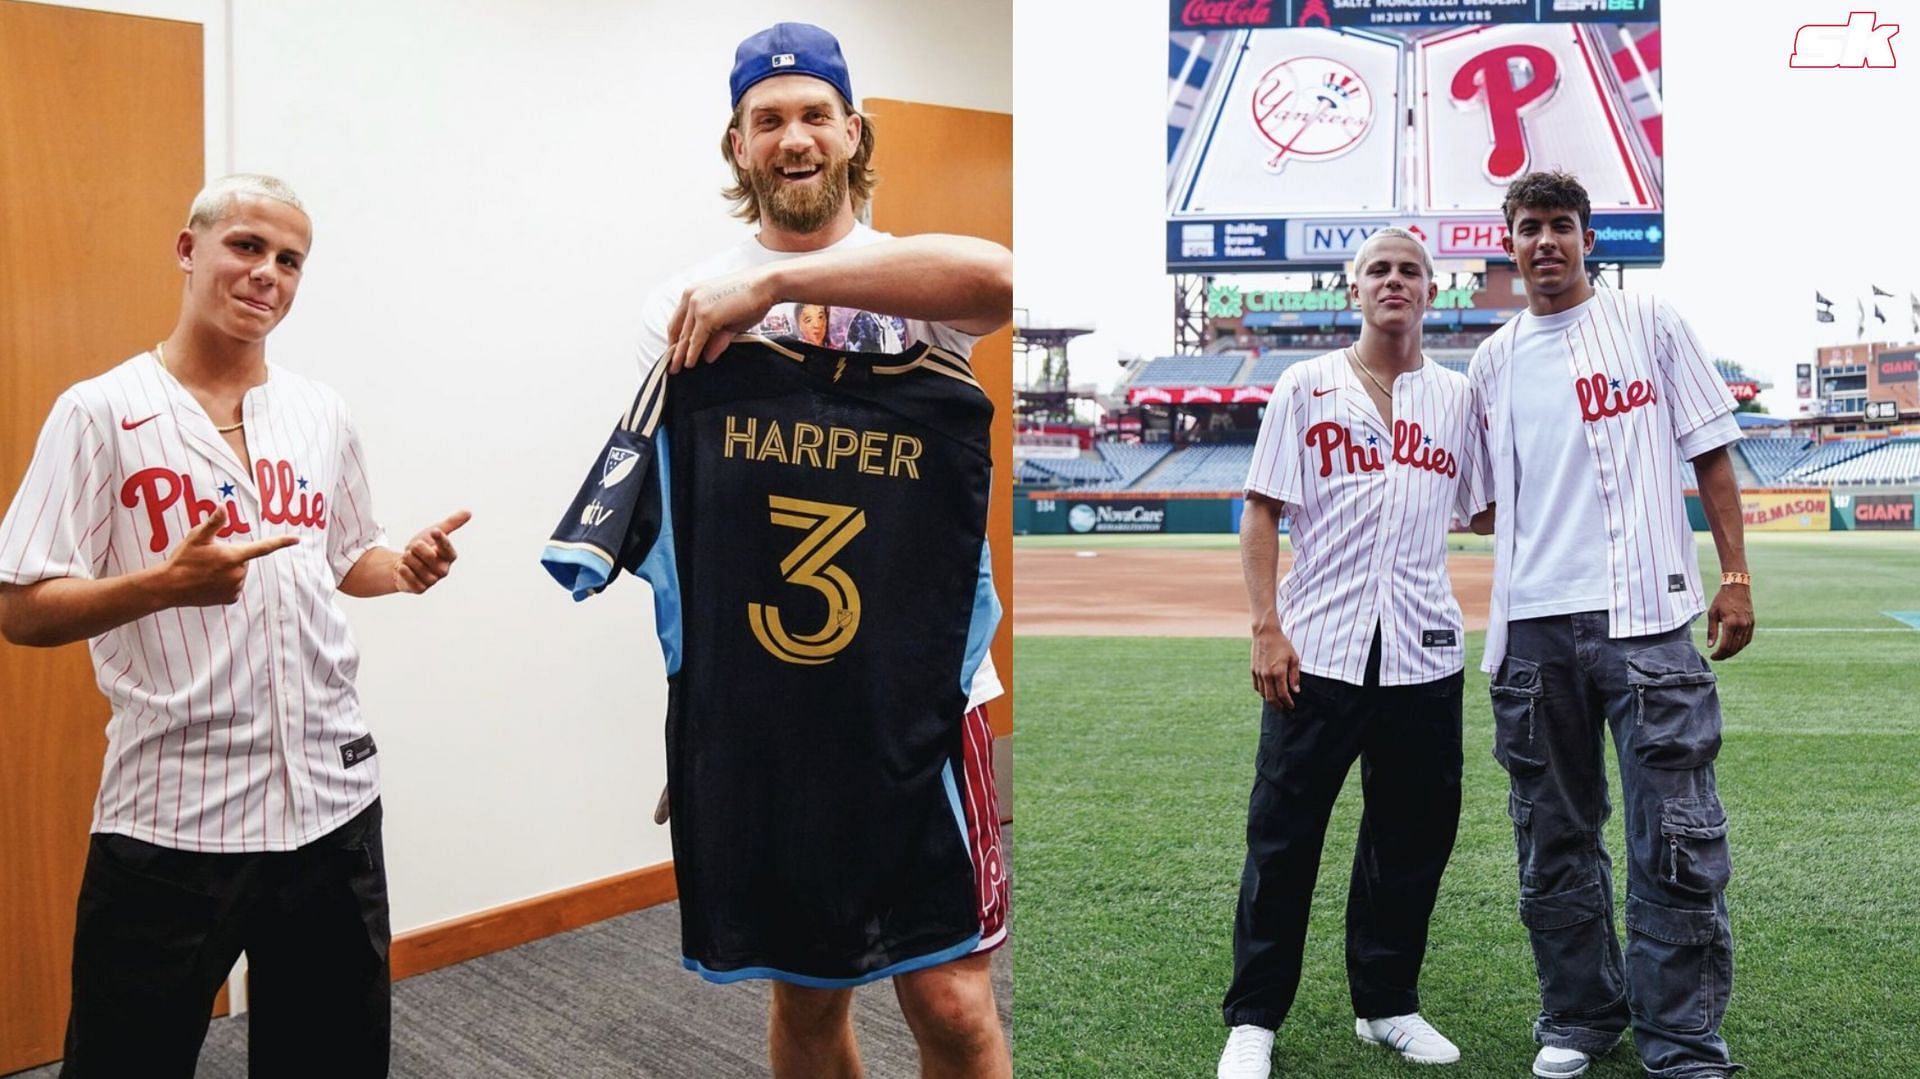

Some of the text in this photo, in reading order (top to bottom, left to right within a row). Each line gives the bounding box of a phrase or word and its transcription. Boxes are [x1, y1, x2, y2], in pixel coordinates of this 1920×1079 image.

[1370, 10, 1492, 23] INJURY LAWYERS
[1596, 226, 1643, 241] ndence
[1246, 290, 1348, 312] Citizens
[724, 415, 923, 481] HARPER
[1096, 506, 1164, 522] NovaCare
[1855, 503, 1913, 520] GIANT
[748, 494, 866, 665] 3
